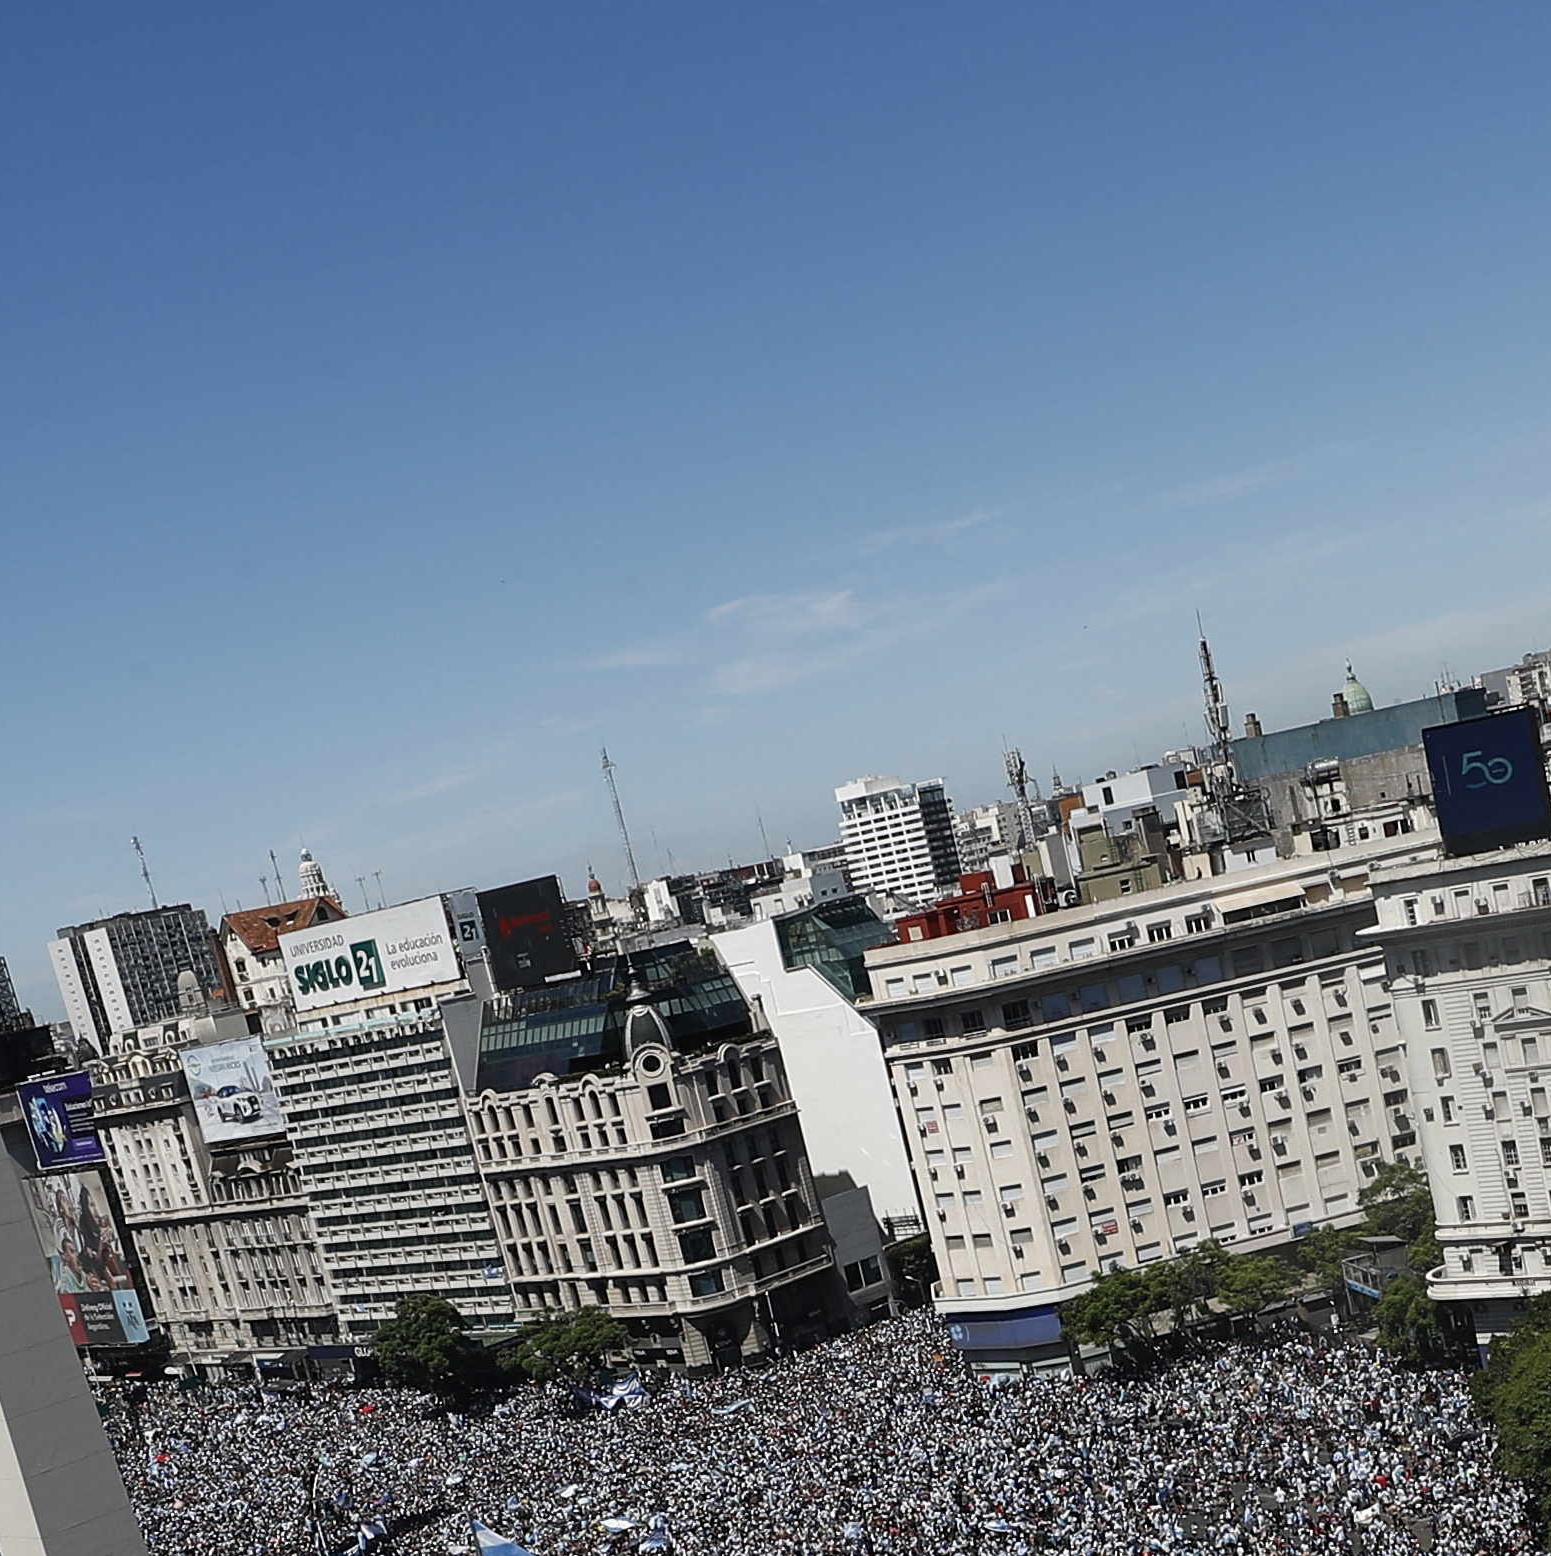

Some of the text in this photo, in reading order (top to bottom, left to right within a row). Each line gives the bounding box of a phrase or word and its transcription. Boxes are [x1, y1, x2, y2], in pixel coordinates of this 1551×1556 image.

[385, 932, 444, 956] La educación
[463, 925, 478, 940] 21
[289, 933, 345, 957] UNIVERSIDAD
[294, 949, 379, 995] SIGLO 21
[390, 952, 439, 971] evoluciona
